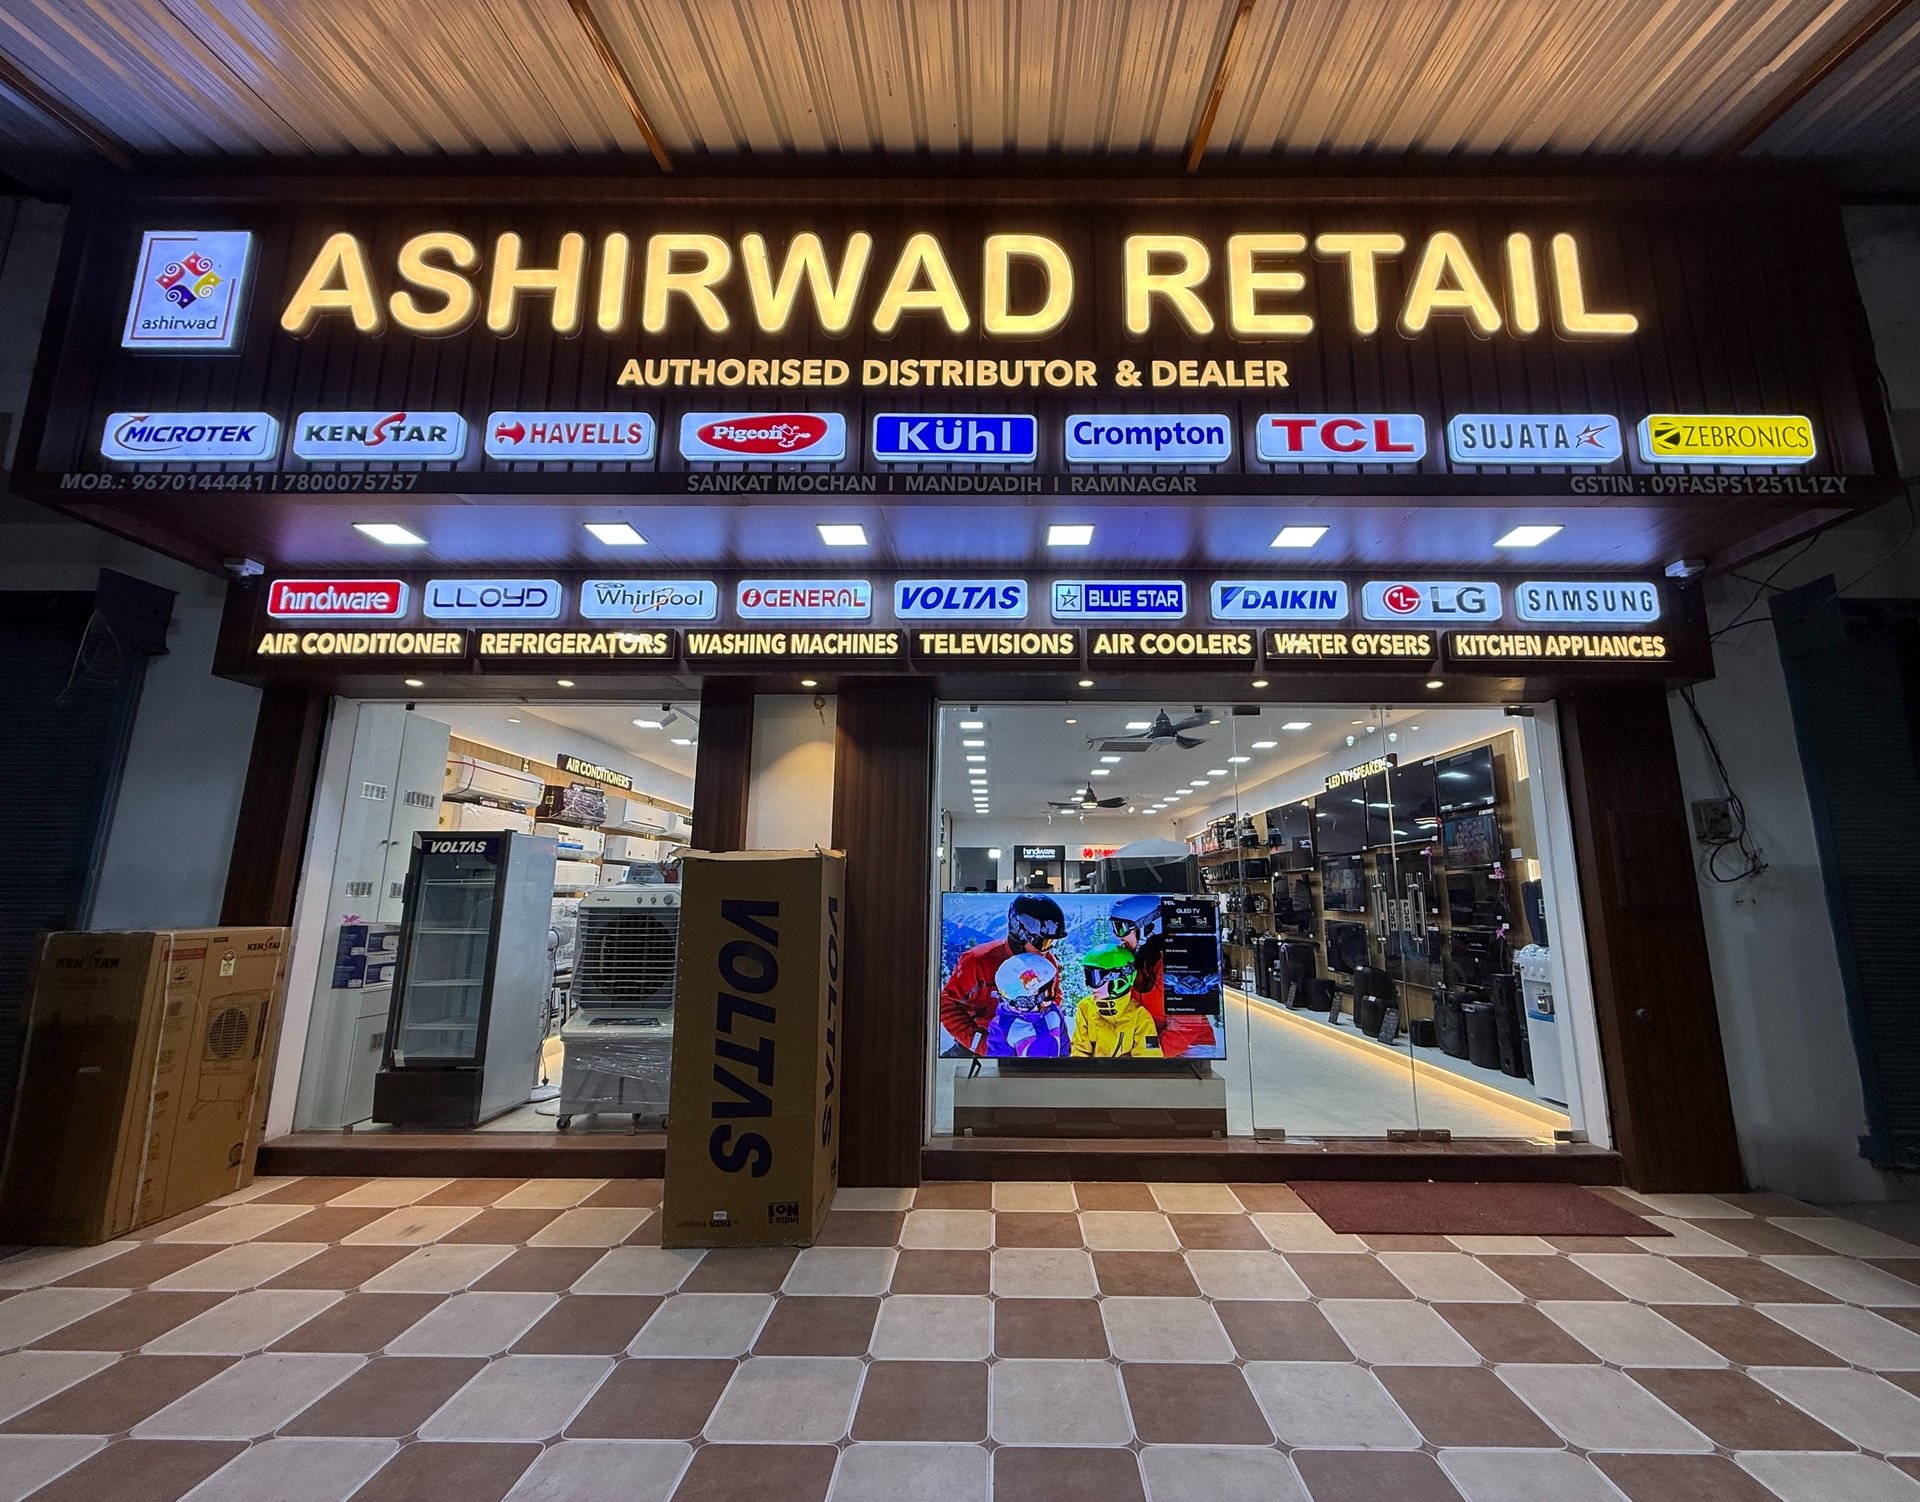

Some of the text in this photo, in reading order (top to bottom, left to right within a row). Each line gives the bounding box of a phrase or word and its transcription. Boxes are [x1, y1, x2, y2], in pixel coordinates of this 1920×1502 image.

[280, 231, 1639, 334] ASHIRWAD RETAIL
[142, 316, 218, 330] ashirwad
[616, 358, 1289, 388] AUTHORISED DISTRIBUTOR & DEALER
[124, 423, 258, 444] MICROTEK
[304, 413, 447, 446] KENSTAR
[529, 421, 643, 445] HAVELLS
[712, 426, 783, 442] Pigeon
[899, 419, 1011, 452] Kühl
[1073, 421, 1225, 448] Crompton
[1270, 418, 1415, 453] TCL
[1462, 422, 1570, 449] SUJATA
[1684, 424, 1810, 449] ZEBRONICS
[131, 473, 264, 491] 9670144441
[284, 473, 418, 491] 7800075757
[687, 474, 773, 491] SANKAT
[777, 475, 876, 492] MOCHAN
[905, 475, 1042, 492] MANDUADIH
[1071, 476, 1197, 492] RAMNAGAR
[1570, 475, 1634, 493] GSTIN
[1651, 475, 1847, 494] 09FASPS1251L1ZY
[280, 585, 390, 611] hindware
[433, 587, 548, 608] LLOYD
[596, 588, 703, 611] Whirlpool
[764, 588, 866, 609] GENERAL
[900, 586, 1021, 610] VOLTAS
[1089, 589, 1179, 608] BLUE STAR
[1244, 589, 1338, 609] DAIKIN
[1430, 586, 1487, 613] LG
[1528, 589, 1653, 612] SAMSUNG
[257, 632, 461, 655] AIR CONDITIONER
[480, 633, 667, 655] REFRIGERATORS
[688, 633, 899, 655] WASHING MACHINES
[920, 633, 1074, 655] TELEVISIONS
[1094, 633, 1252, 655] AIR COOLERS
[1274, 633, 1431, 656] WATER GYSERS
[1456, 634, 1666, 658] KITCHEN APPLIANCES
[565, 757, 629, 788] AIR CONDITIONERS
[1328, 774, 1341, 790] LED
[430, 840, 487, 853] VOLTAS
[1023, 847, 1056, 855] hindware
[1389, 901, 1397, 929] PUSH
[1403, 901, 1411, 929] PUSH
[821, 896, 838, 1148] VOLTAS
[709, 898, 780, 1178] VOLTAS
[677, 1219, 707, 1228] Product
[709, 1219, 732, 1228] TATA
